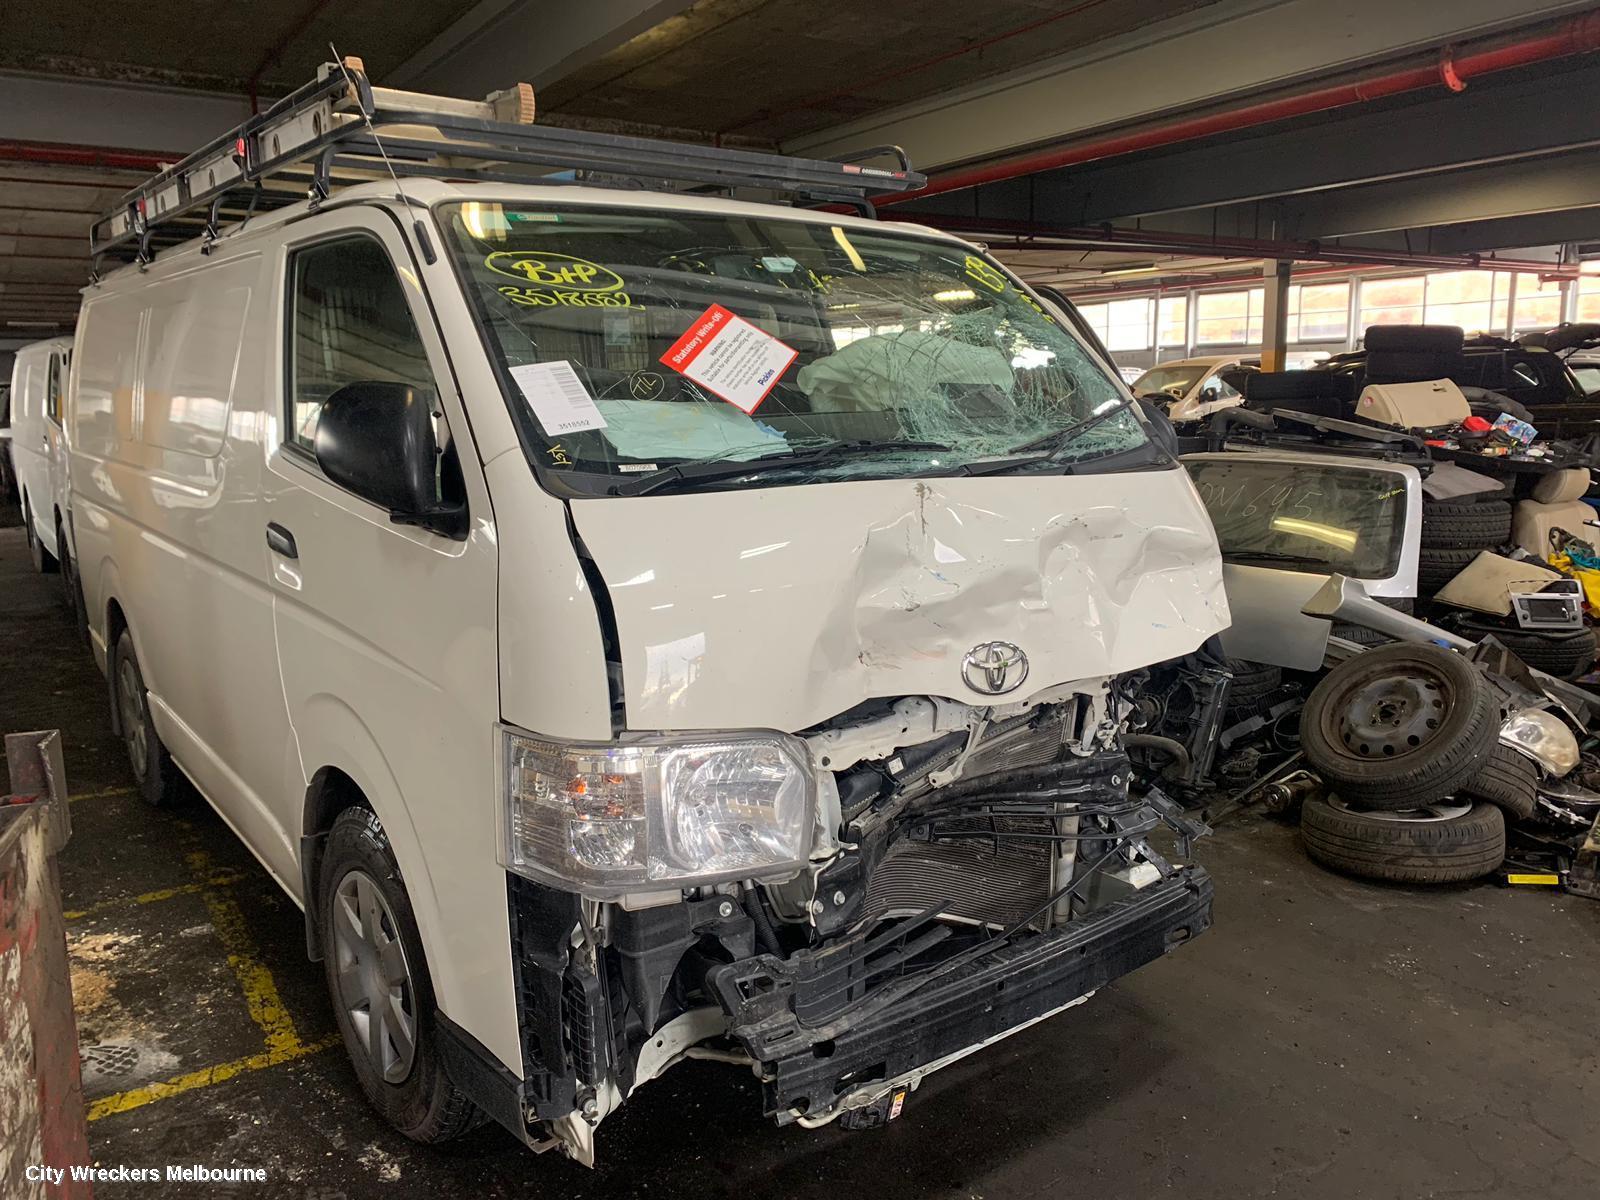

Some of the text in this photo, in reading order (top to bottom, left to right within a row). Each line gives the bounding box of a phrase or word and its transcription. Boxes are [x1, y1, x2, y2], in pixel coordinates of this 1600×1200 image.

[671, 310, 724, 364] Statutory Write-Off
[756, 367, 775, 386] Pickles
[558, 419, 590, 430] 3518552
